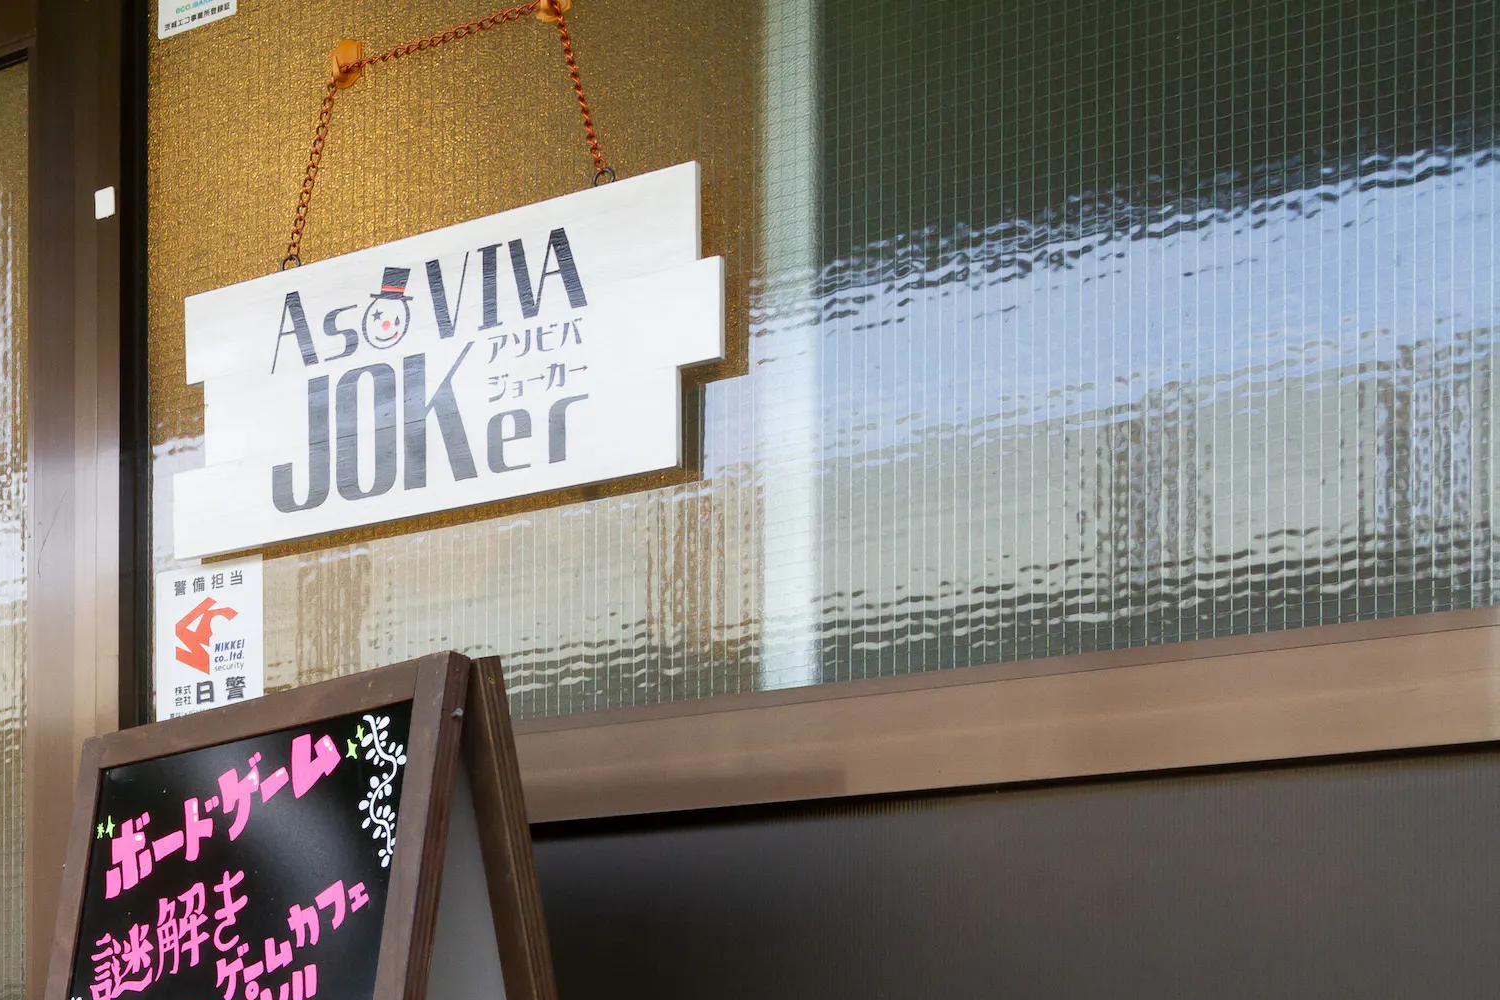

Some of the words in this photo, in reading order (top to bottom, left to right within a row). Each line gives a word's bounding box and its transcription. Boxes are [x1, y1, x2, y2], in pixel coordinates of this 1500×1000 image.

[487, 318, 583, 364] アソビバ
[488, 362, 590, 402] ジョーカー
[174, 570, 243, 597] 警備担当
[214, 639, 245, 653] NIKKEI
[214, 661, 244, 672] security
[196, 676, 246, 705] 日警
[104, 733, 342, 899] ボードゲーム
